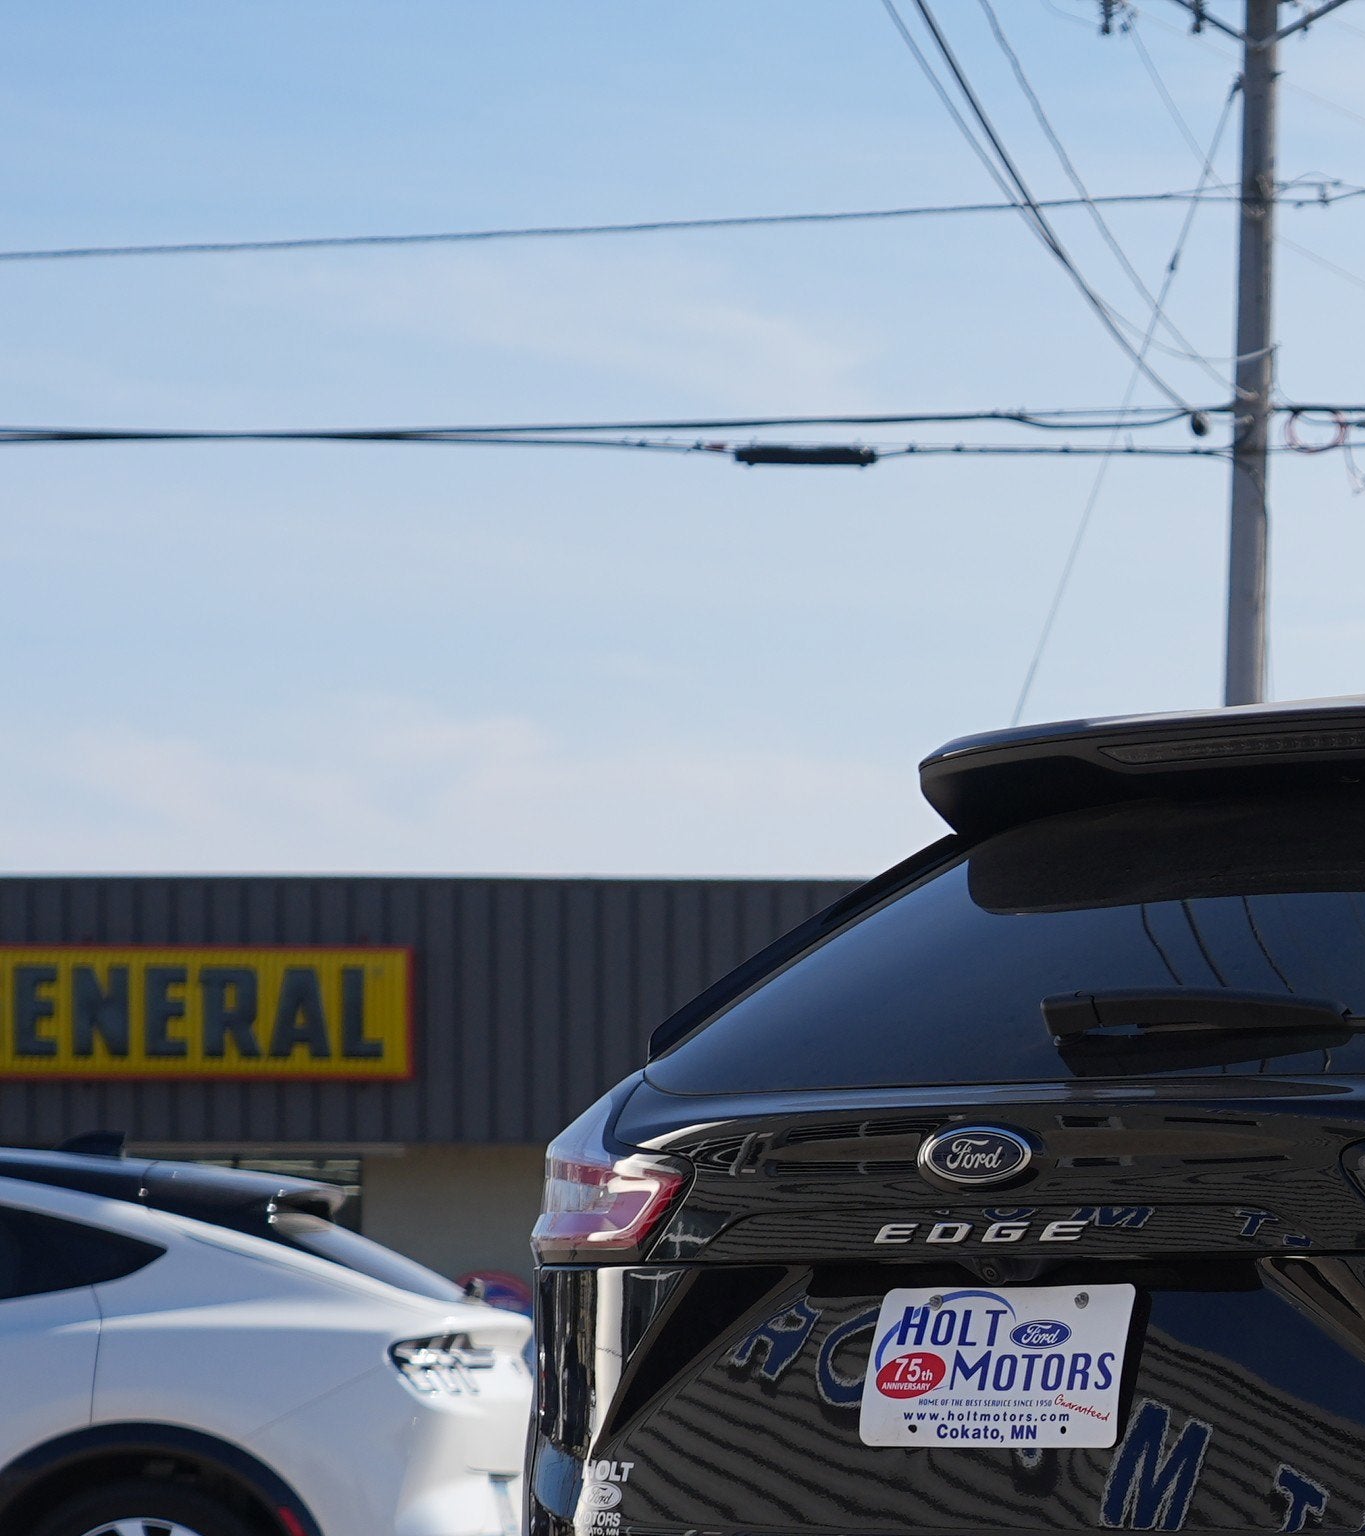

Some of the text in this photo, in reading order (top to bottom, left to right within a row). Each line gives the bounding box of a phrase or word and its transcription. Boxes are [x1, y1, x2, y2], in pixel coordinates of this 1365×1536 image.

[12, 964, 385, 1058] ENERAL
[946, 1138, 1004, 1170] Ford
[873, 1220, 1089, 1244] EDGE
[896, 1306, 1008, 1347] HOLT
[1021, 1323, 1060, 1345] Ford
[893, 1357, 934, 1382] 75th
[949, 1350, 1116, 1392] MOTORS
[881, 1380, 932, 1391] ANNIVERSARY
[918, 1398, 939, 1406] HOME
[951, 1399, 964, 1407] THE
[965, 1399, 983, 1407] BEST
[1054, 1393, 1111, 1422] Guaranteed
[903, 1410, 1070, 1422] www.holtmotors.com
[936, 1423, 1038, 1443] Cokato, MN
[581, 1459, 635, 1483] HOLT
[577, 1511, 621, 1527] OTORS
